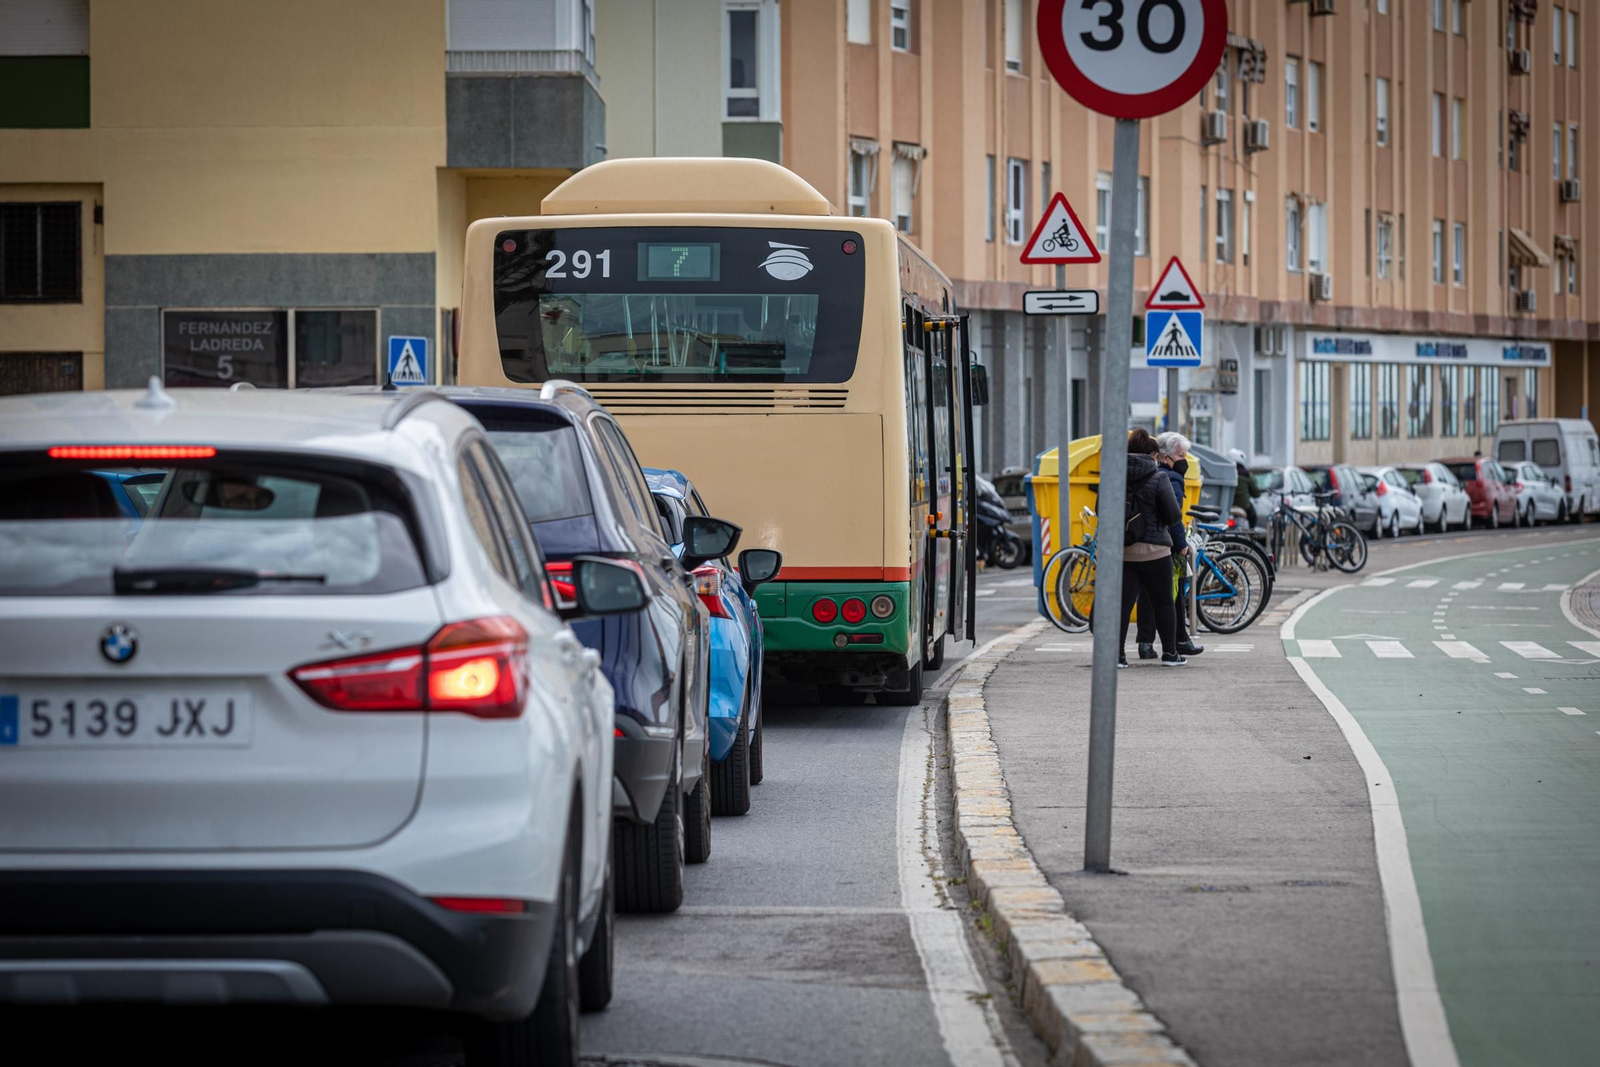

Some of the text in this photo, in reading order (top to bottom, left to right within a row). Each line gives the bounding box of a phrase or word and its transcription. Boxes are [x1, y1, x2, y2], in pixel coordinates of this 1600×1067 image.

[1079, 0, 1186, 54] 30
[545, 249, 611, 278] 291
[671, 247, 688, 276] 7
[179, 318, 273, 335] FERNÁNDEZ
[190, 339, 264, 351] LADREDA
[217, 355, 233, 379] 5
[31, 699, 235, 738] 5139 JXJ
